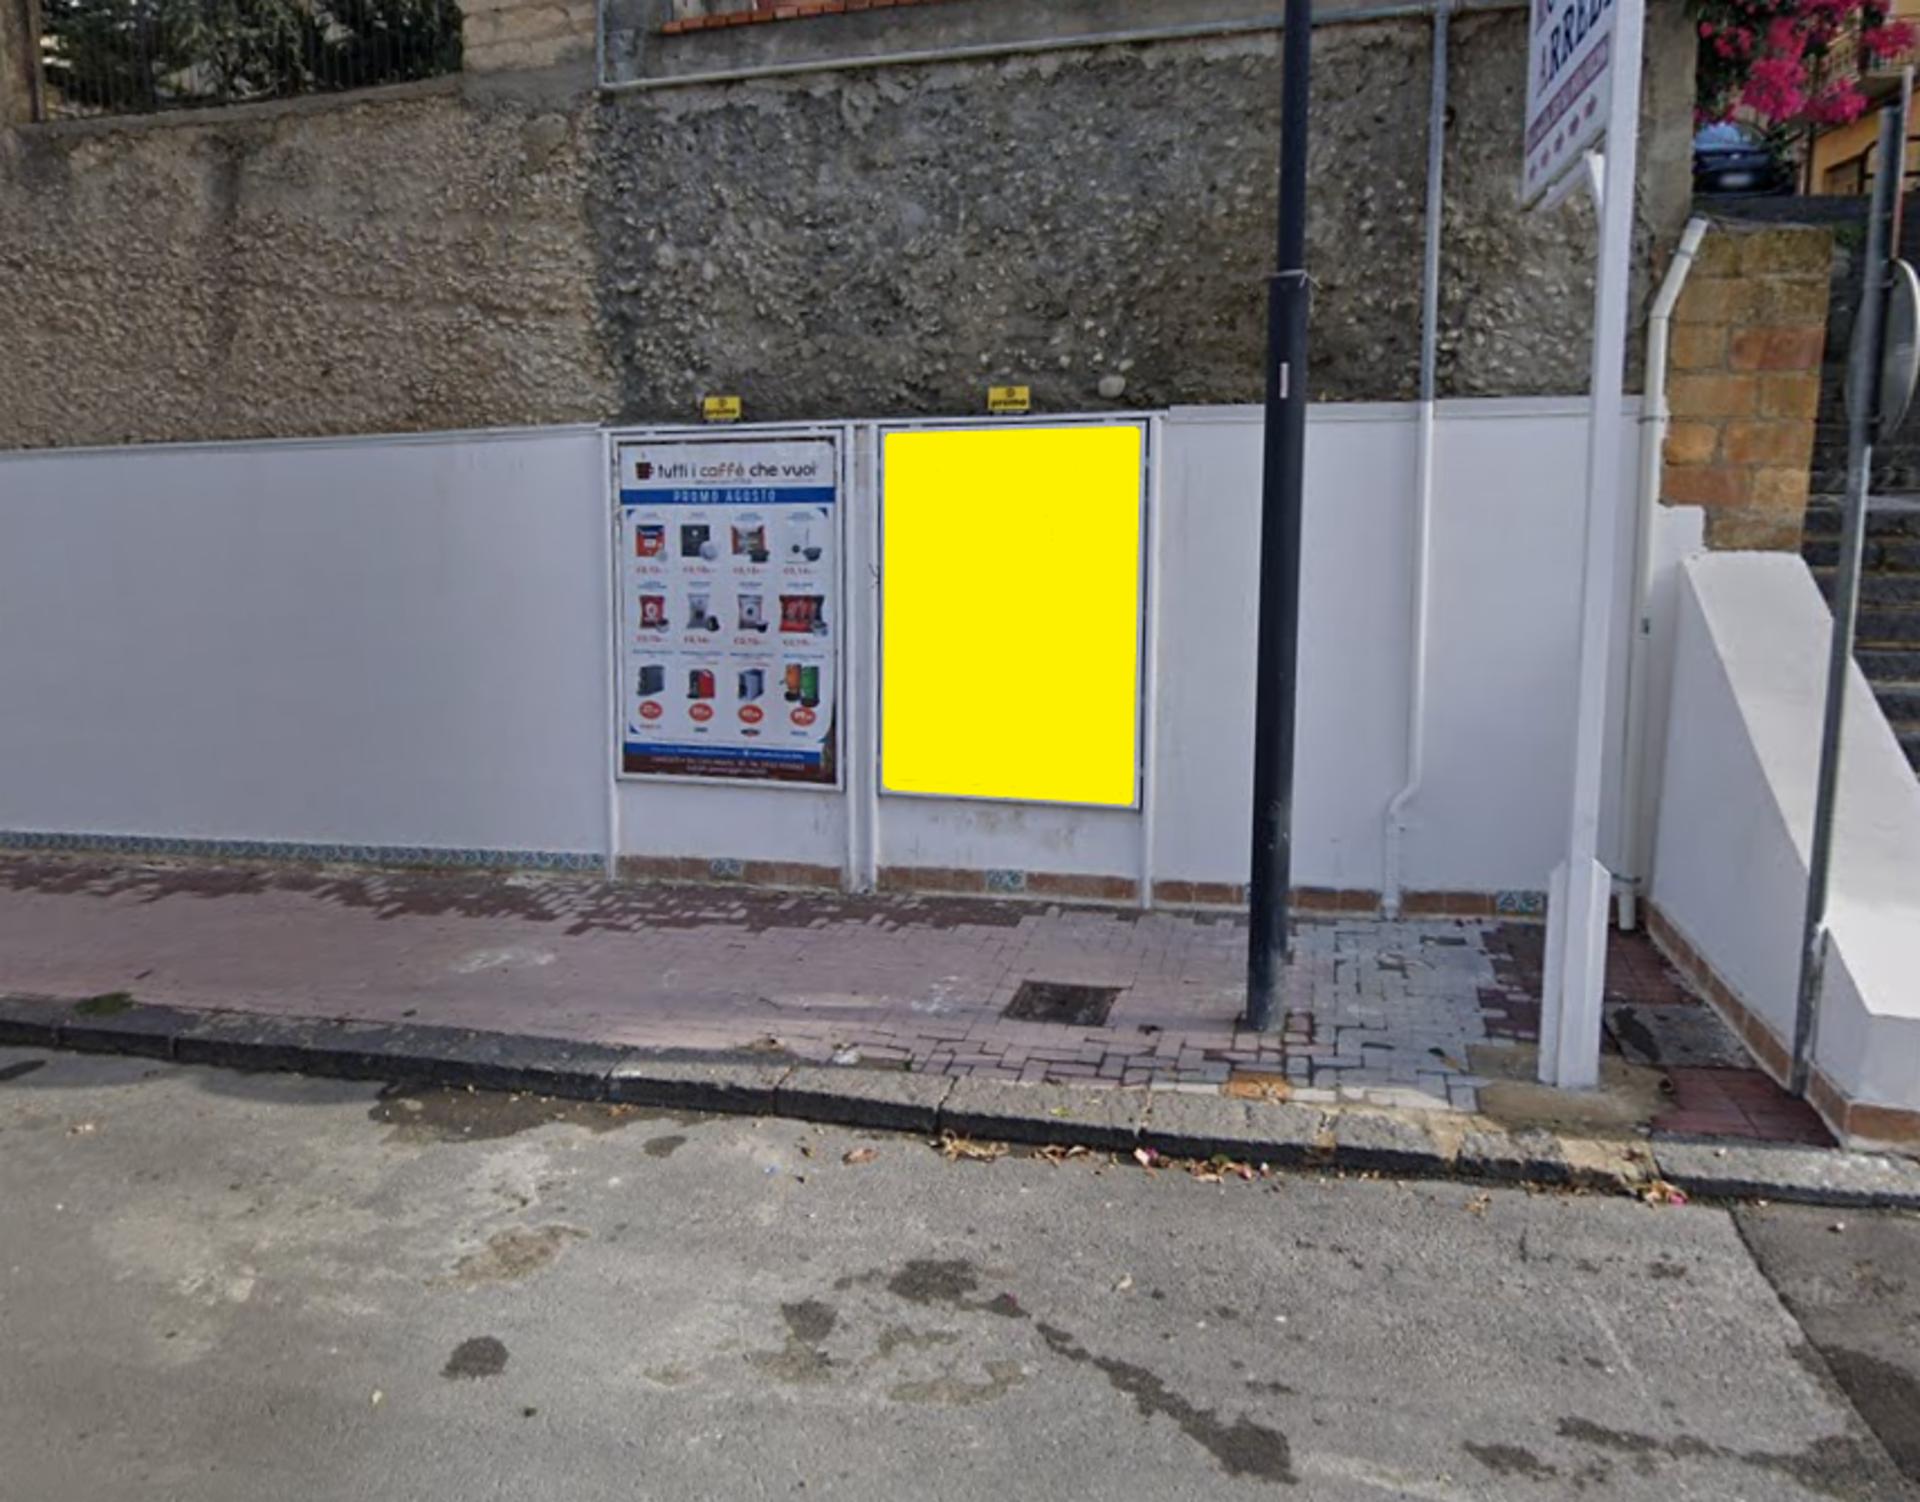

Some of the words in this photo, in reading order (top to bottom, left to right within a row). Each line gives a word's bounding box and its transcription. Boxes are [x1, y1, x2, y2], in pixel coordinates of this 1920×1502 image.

[658, 463, 687, 479] tutti
[749, 462, 778, 478] che
[783, 461, 816, 477] vuoi
[673, 490, 719, 502] PROMO
[725, 489, 776, 502] AGOSTO
